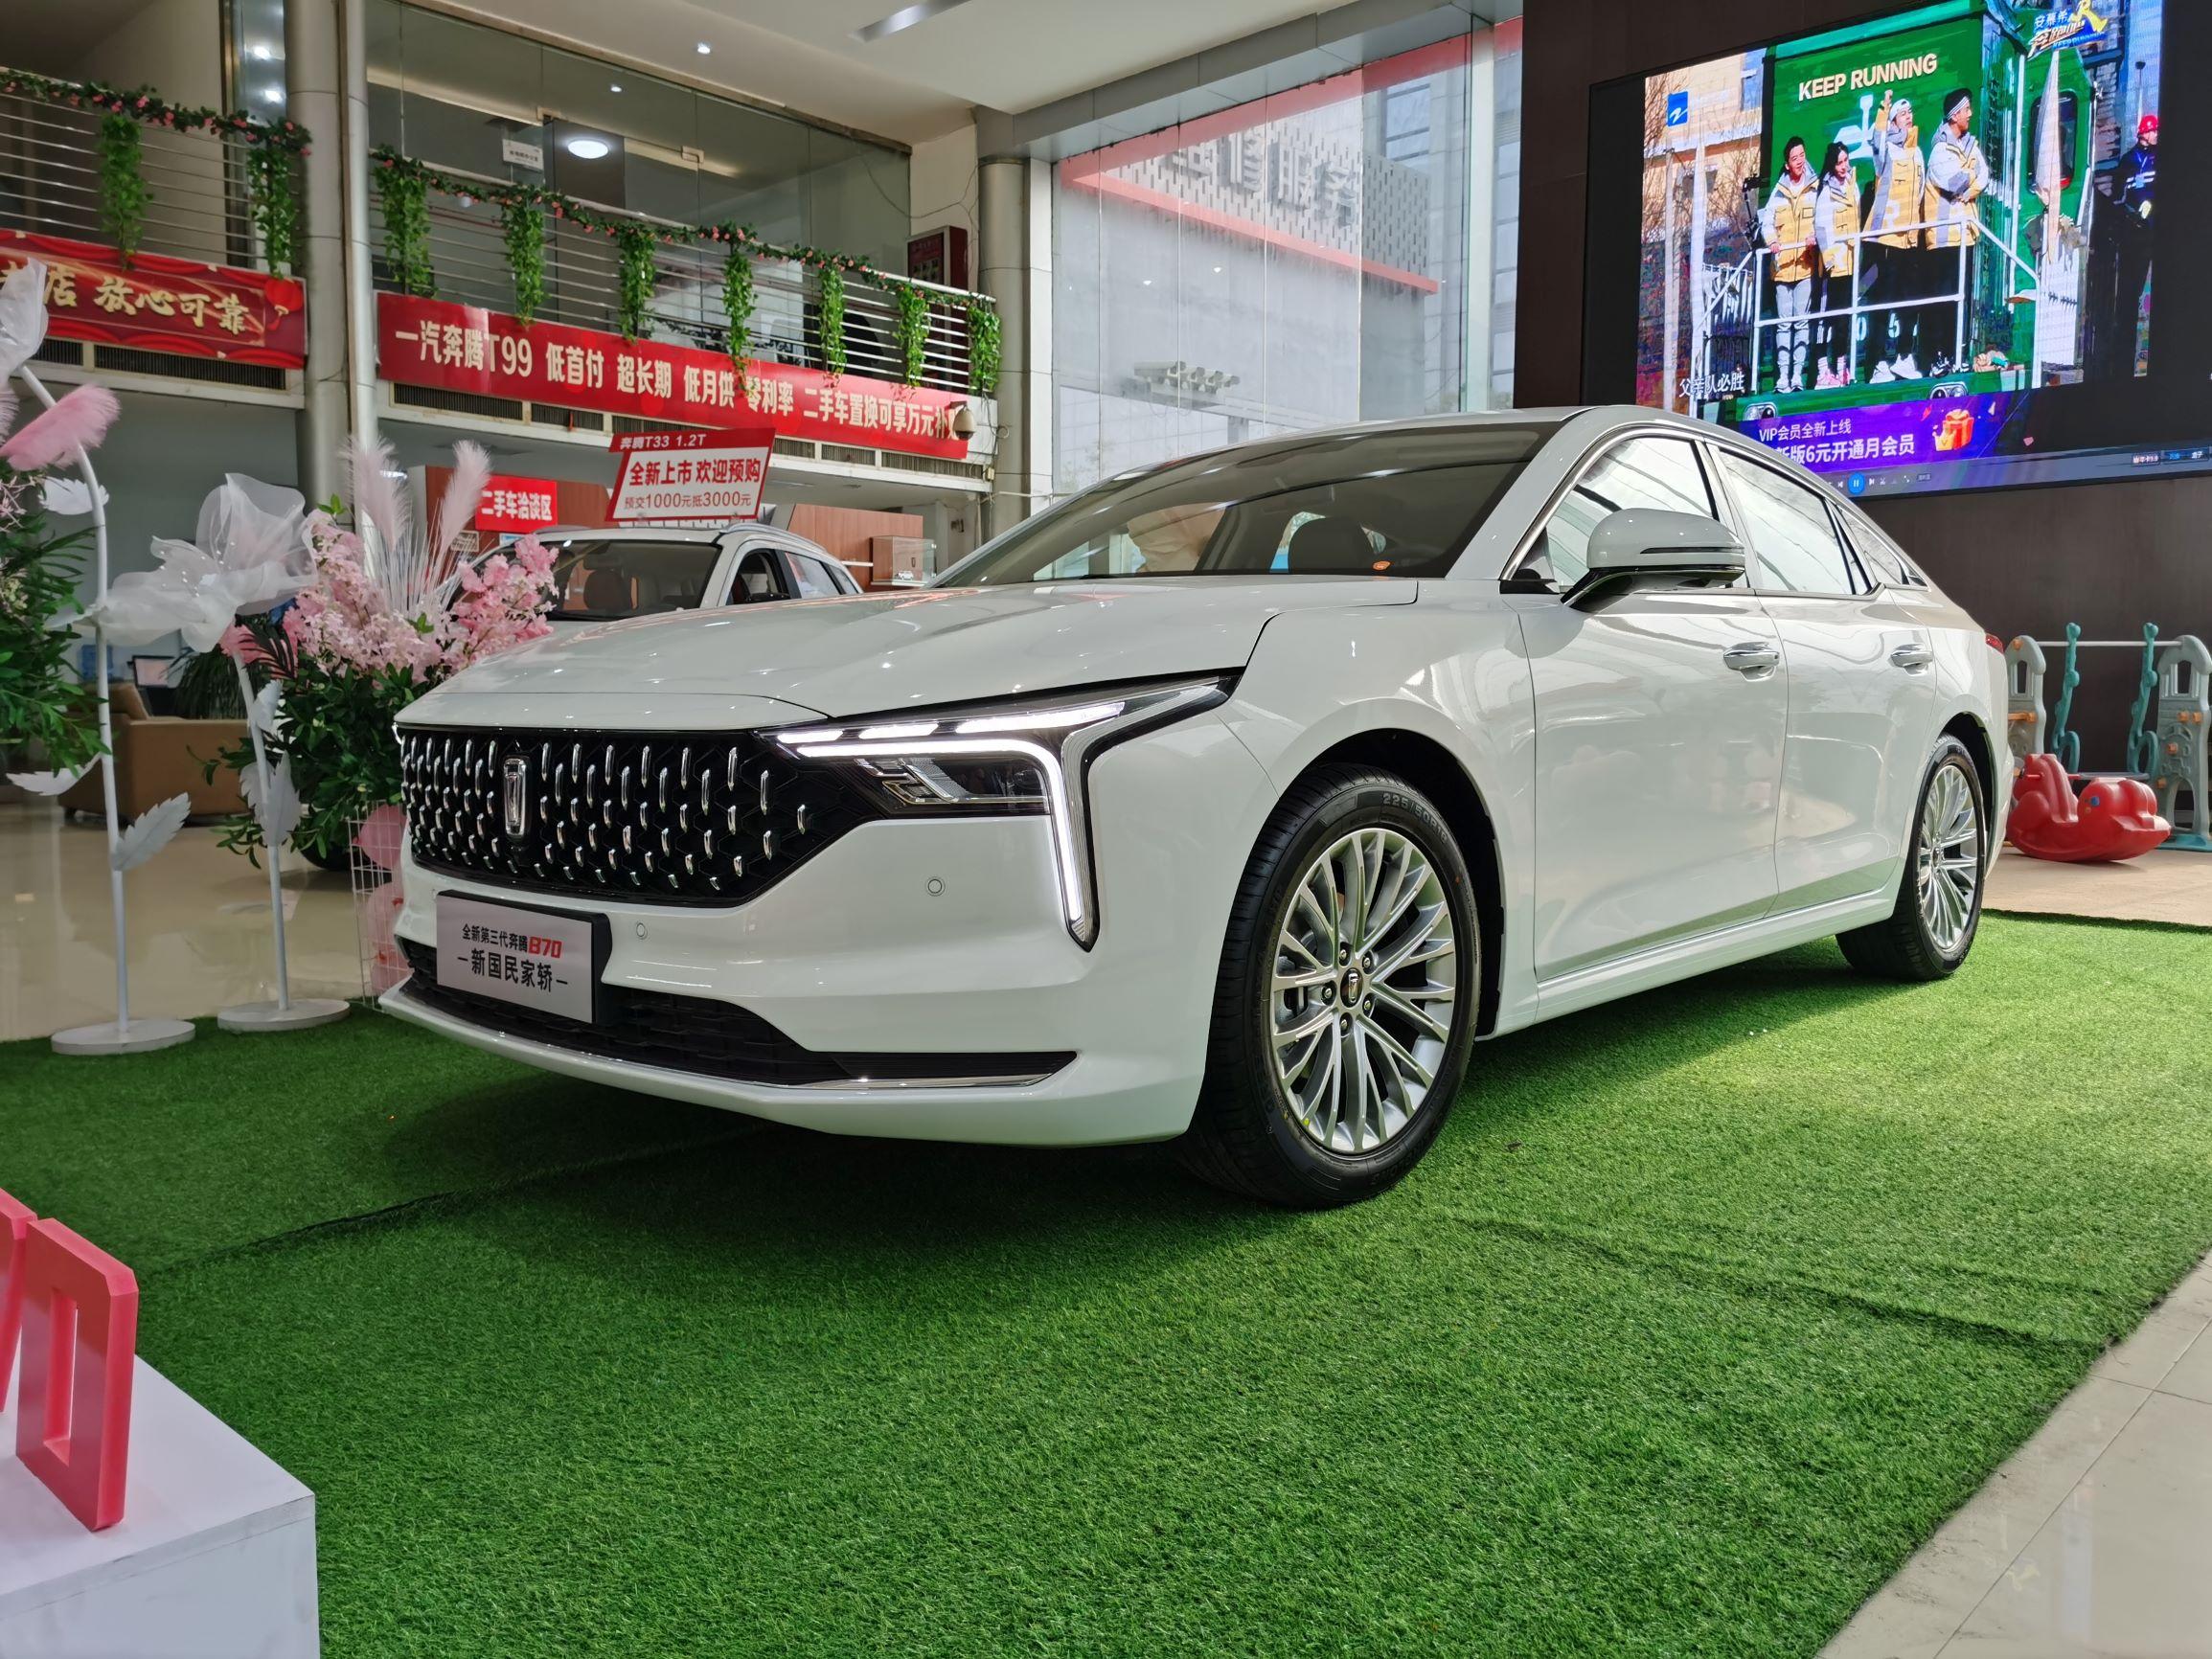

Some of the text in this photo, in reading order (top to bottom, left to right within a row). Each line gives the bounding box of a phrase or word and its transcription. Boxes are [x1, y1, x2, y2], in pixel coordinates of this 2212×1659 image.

[1798, 53, 1938, 102] KEEP RUNNING
[94, 275, 249, 336] 放心可靠
[395, 319, 534, 378] 一汽奔腾T99
[545, 342, 605, 390] 低首付
[616, 352, 673, 399] 超长期
[683, 364, 736, 409] 低月供
[745, 375, 794, 417] 零利率
[1678, 371, 1745, 398] 父亲队必胜
[675, 433, 708, 447] 1.2T
[1759, 418, 1853, 443] VIP会员全新上线
[628, 458, 763, 487] 全新上市 欢迎预购
[481, 489, 553, 522] 二手车洽谈区
[624, 489, 752, 511] 预交1000元抵3000元
[462, 922, 563, 960] 全新第三代奔腾B70
